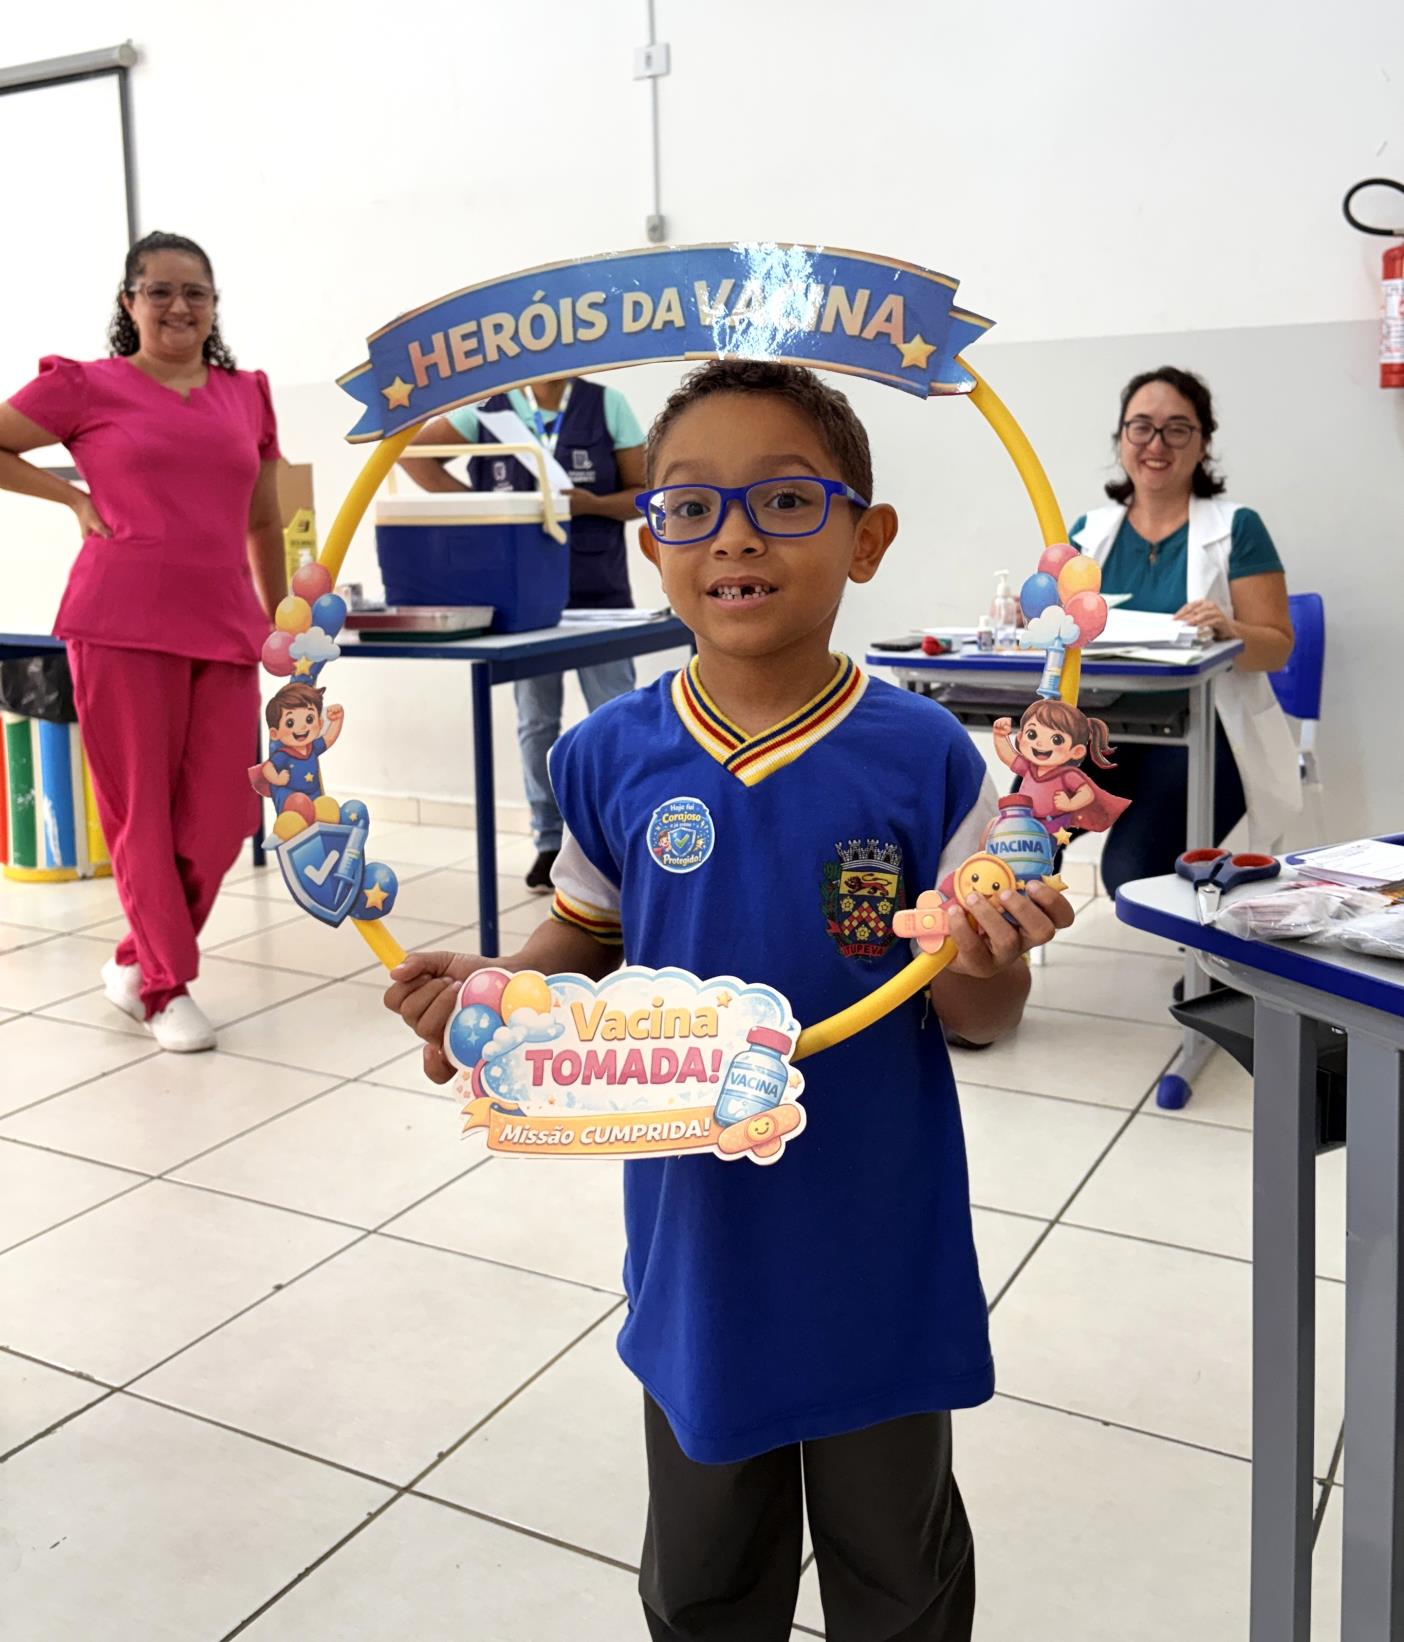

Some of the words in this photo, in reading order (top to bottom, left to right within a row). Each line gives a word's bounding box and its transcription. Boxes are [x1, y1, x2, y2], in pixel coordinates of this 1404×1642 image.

[408, 290, 607, 388] HERÓIS
[623, 289, 685, 333] DA
[662, 811, 701, 824] Corajoso
[663, 851, 702, 867] Protegido!
[990, 840, 1044, 855] VACINA
[570, 996, 719, 1041] Vacina
[525, 1047, 723, 1086] TOMADA!
[730, 1074, 779, 1098] VACINA
[499, 1125, 574, 1146] Missão
[580, 1120, 711, 1146] CUMPRIDA!
